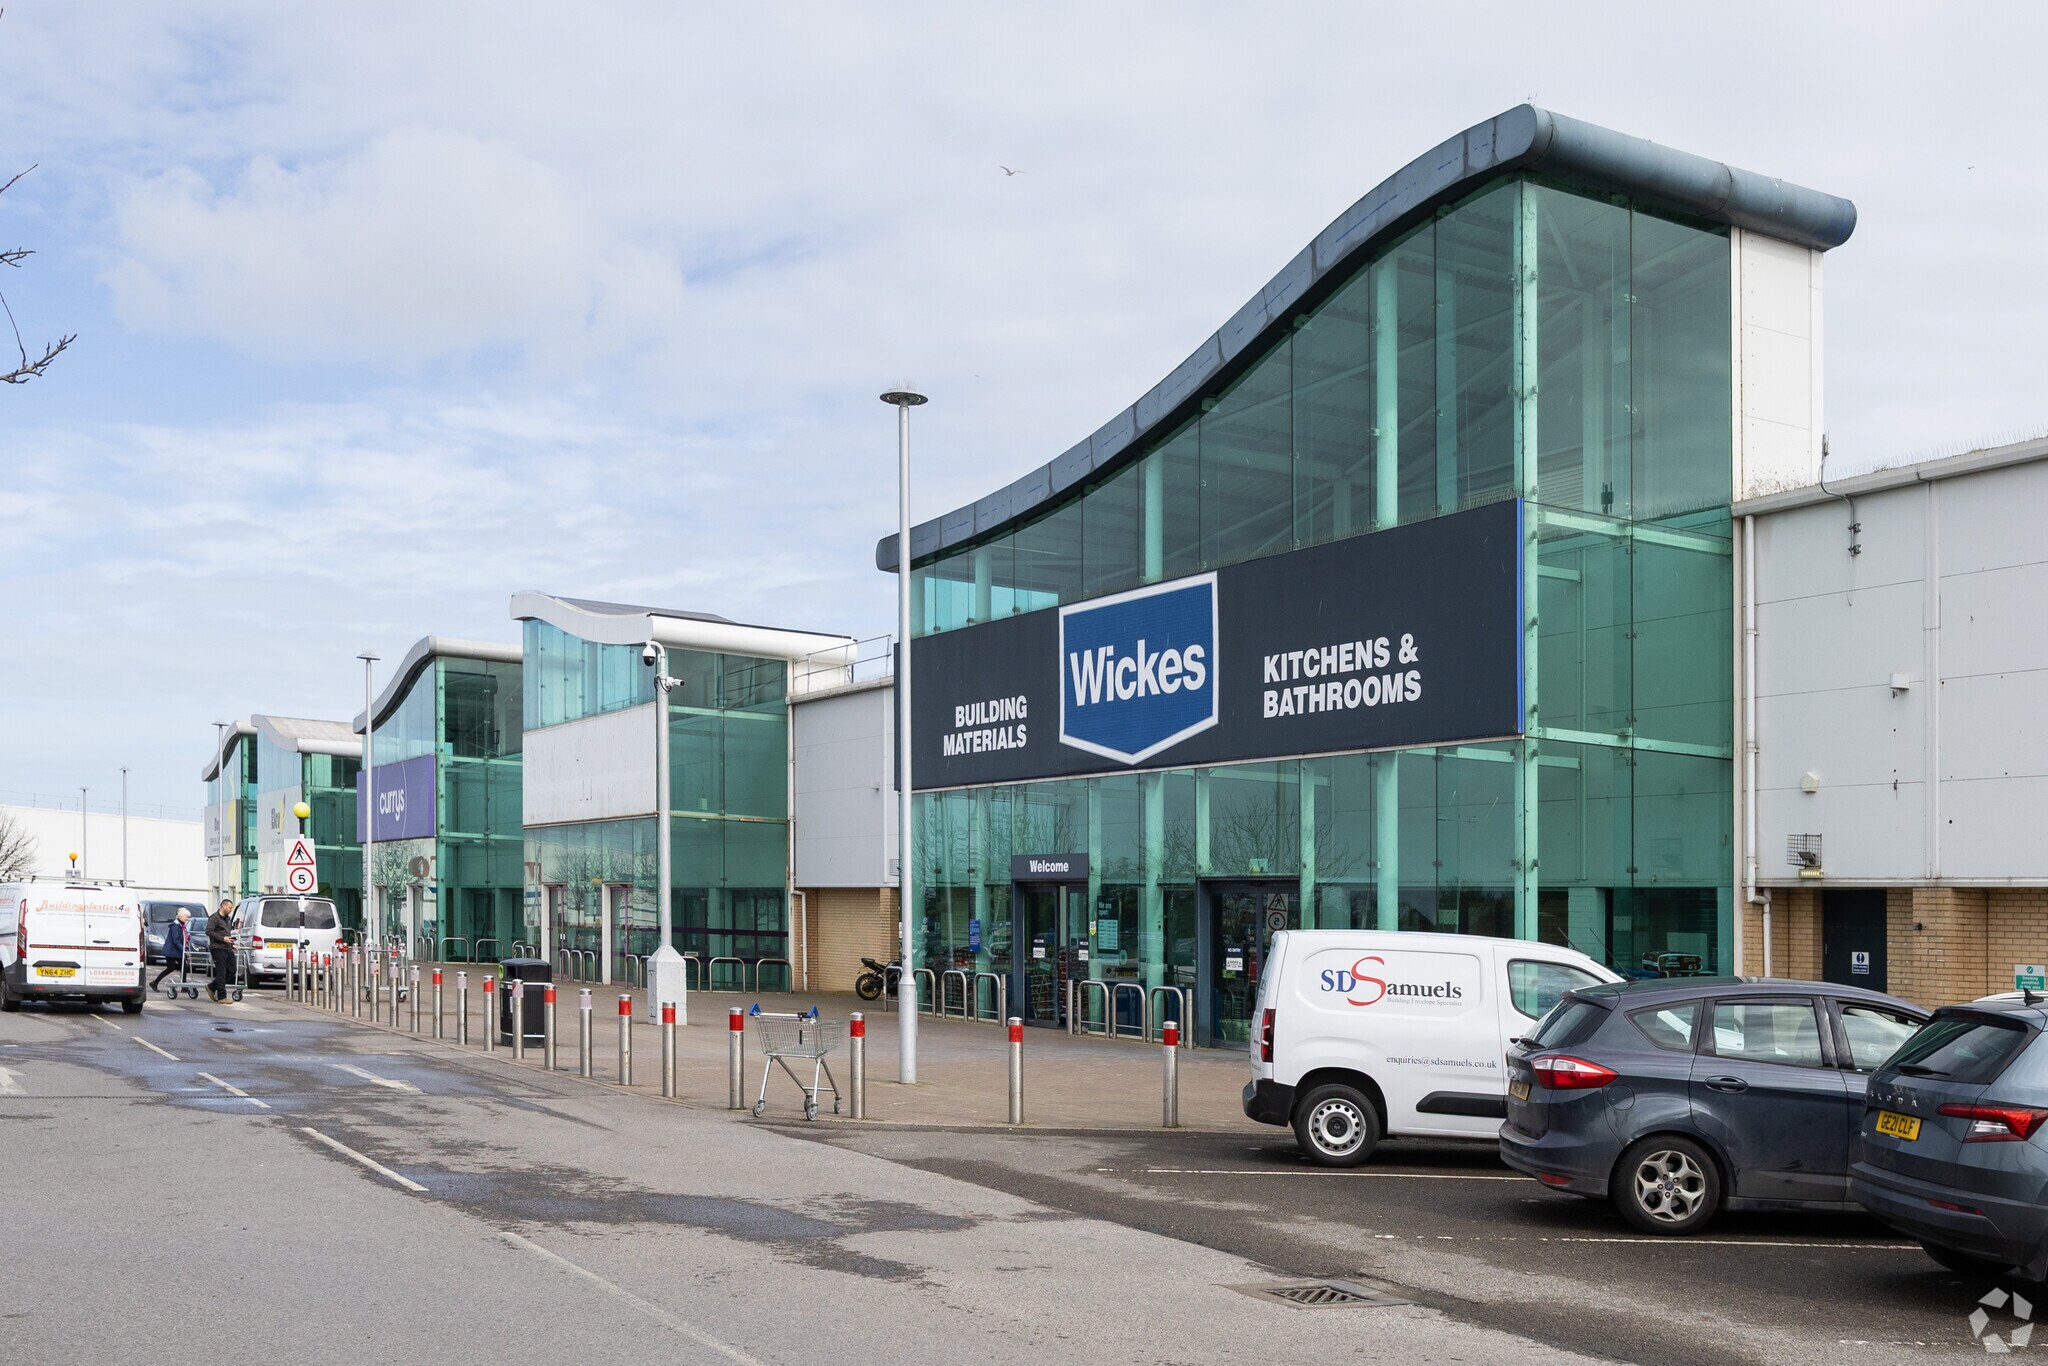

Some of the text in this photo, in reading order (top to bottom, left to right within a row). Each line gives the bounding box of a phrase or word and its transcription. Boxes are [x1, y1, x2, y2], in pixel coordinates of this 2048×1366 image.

[1071, 640, 1206, 707] Wickes
[1264, 633, 1419, 684] KITCHENS &
[1263, 670, 1422, 719] BATHROOMS
[956, 696, 1028, 728] BUILDING
[943, 725, 1028, 757] MATERIALS
[380, 789, 404, 821] currys
[298, 875, 306, 885] 5
[1030, 860, 1069, 873] Welcome
[1387, 997, 1410, 1005] Building
[1386, 1056, 1497, 1069] enquiries@sdsamuels.co.uk
[1880, 1114, 1915, 1135] GE21 CLF
